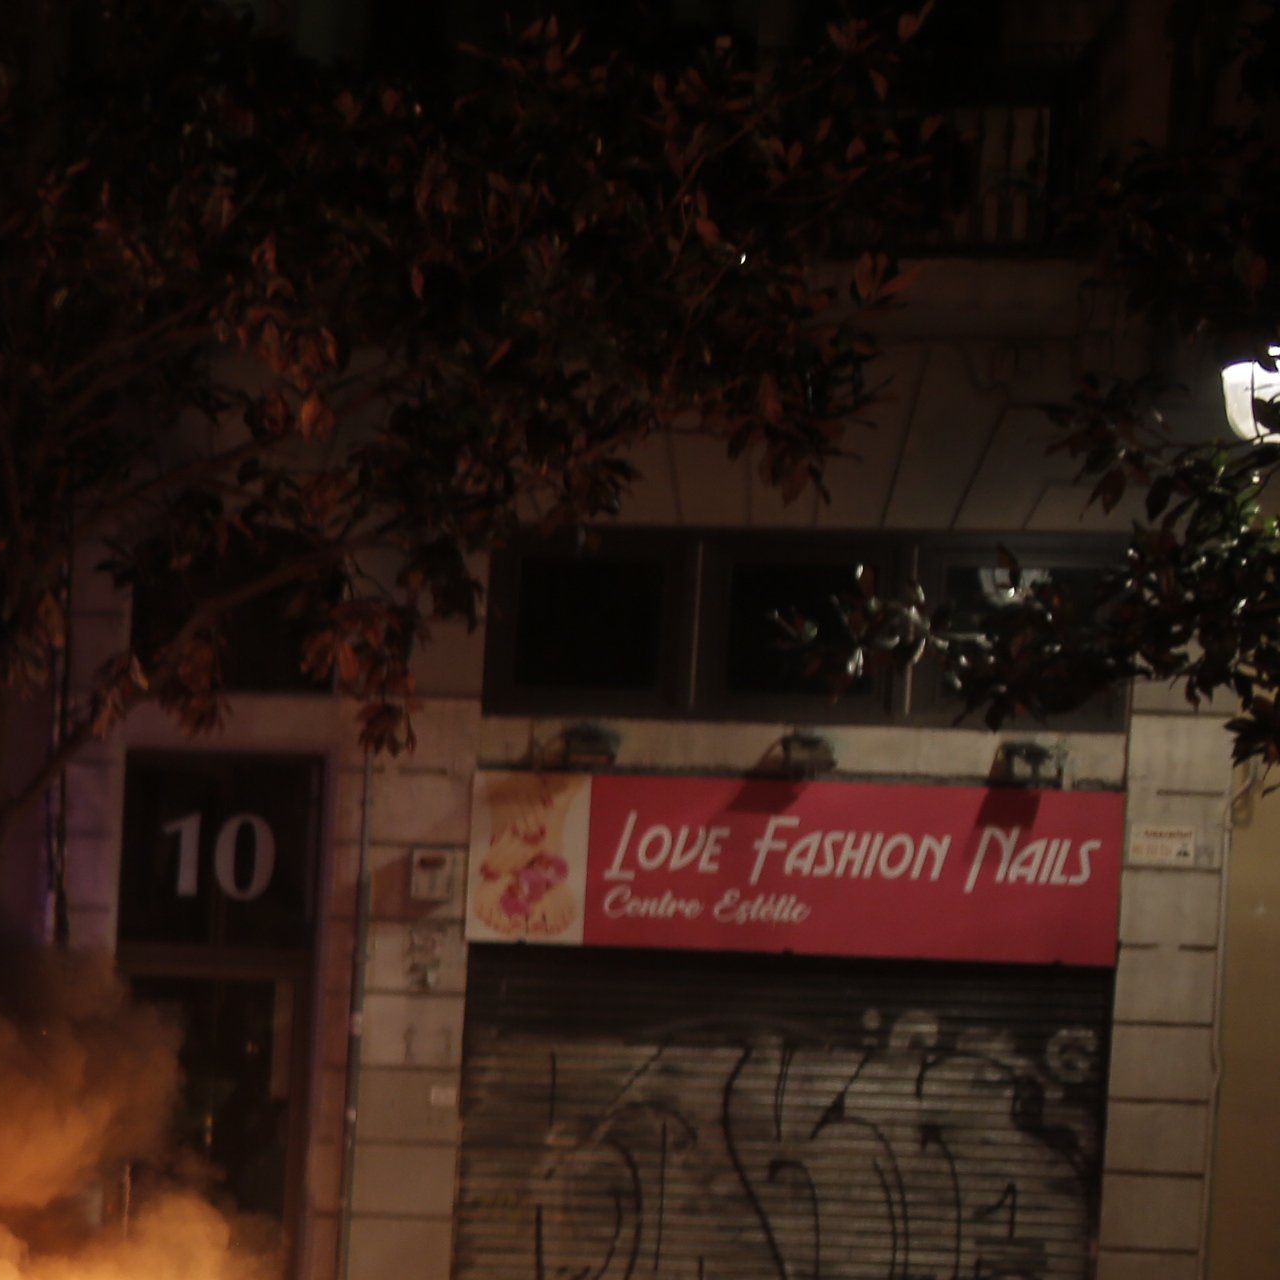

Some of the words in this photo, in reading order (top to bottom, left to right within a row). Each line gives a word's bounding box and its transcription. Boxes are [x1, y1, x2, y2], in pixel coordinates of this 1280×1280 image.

[161, 812, 276, 902] 10
[603, 809, 731, 881] LOVE
[749, 815, 952, 886] FASHION
[963, 824, 1102, 894] NAILS
[603, 884, 704, 919] Centre
